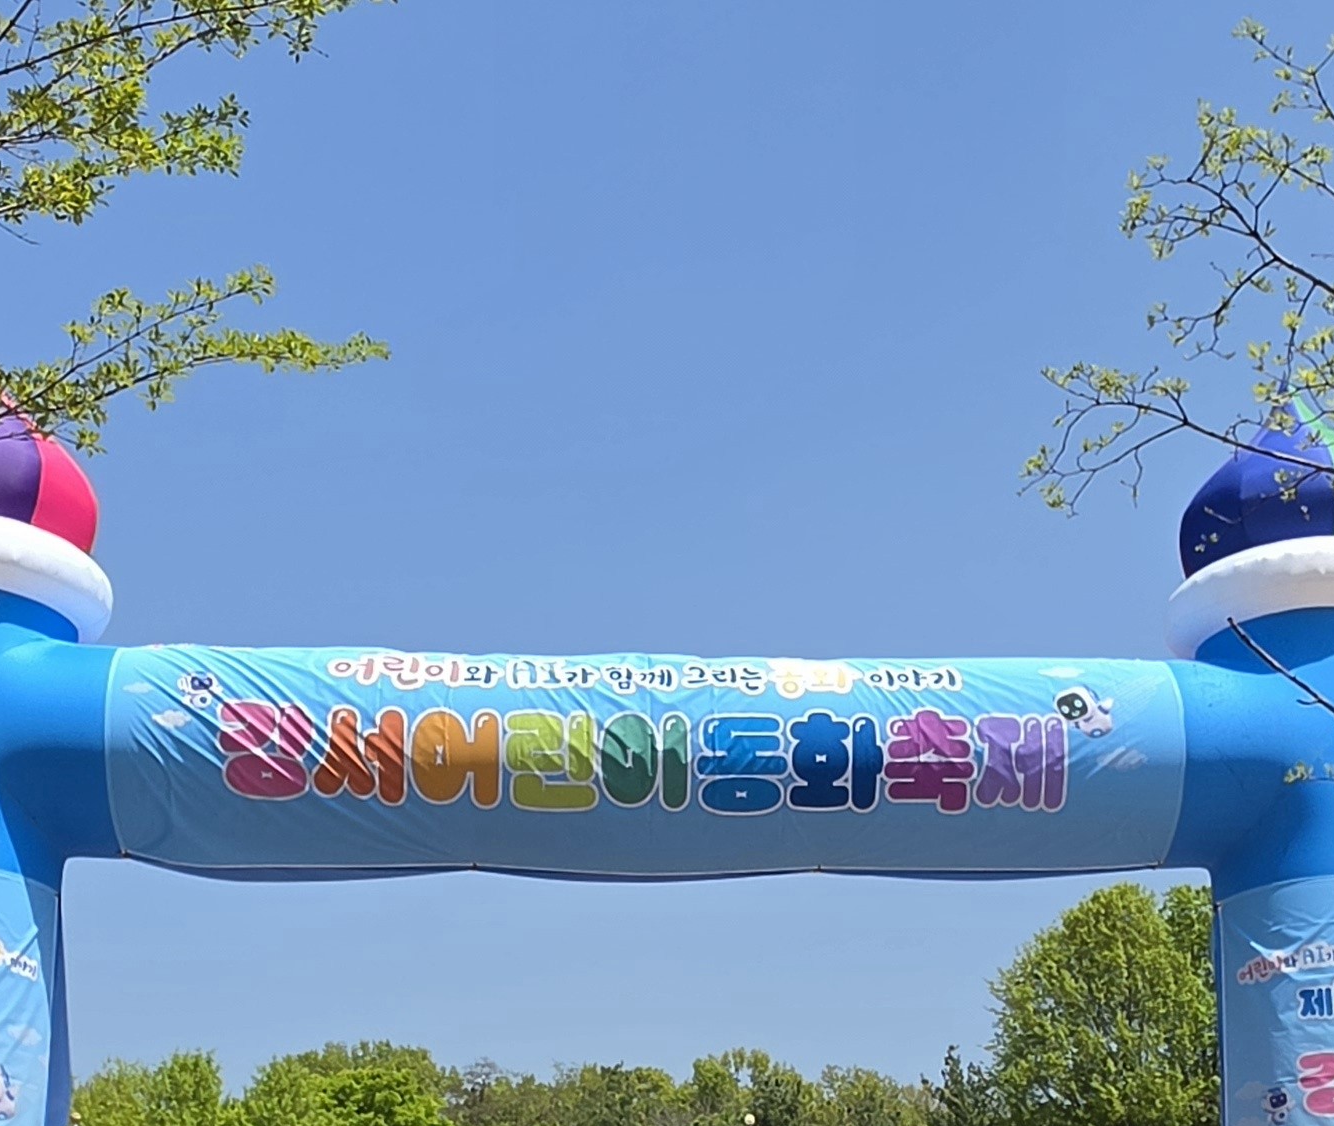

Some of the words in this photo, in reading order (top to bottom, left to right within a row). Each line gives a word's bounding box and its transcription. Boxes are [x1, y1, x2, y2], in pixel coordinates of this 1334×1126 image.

[333, 655, 498, 687] 어린이와
[512, 660, 595, 685] AI가
[608, 665, 672, 689] 함께
[684, 664, 764, 688] 그리는
[870, 667, 956, 690] 이야기
